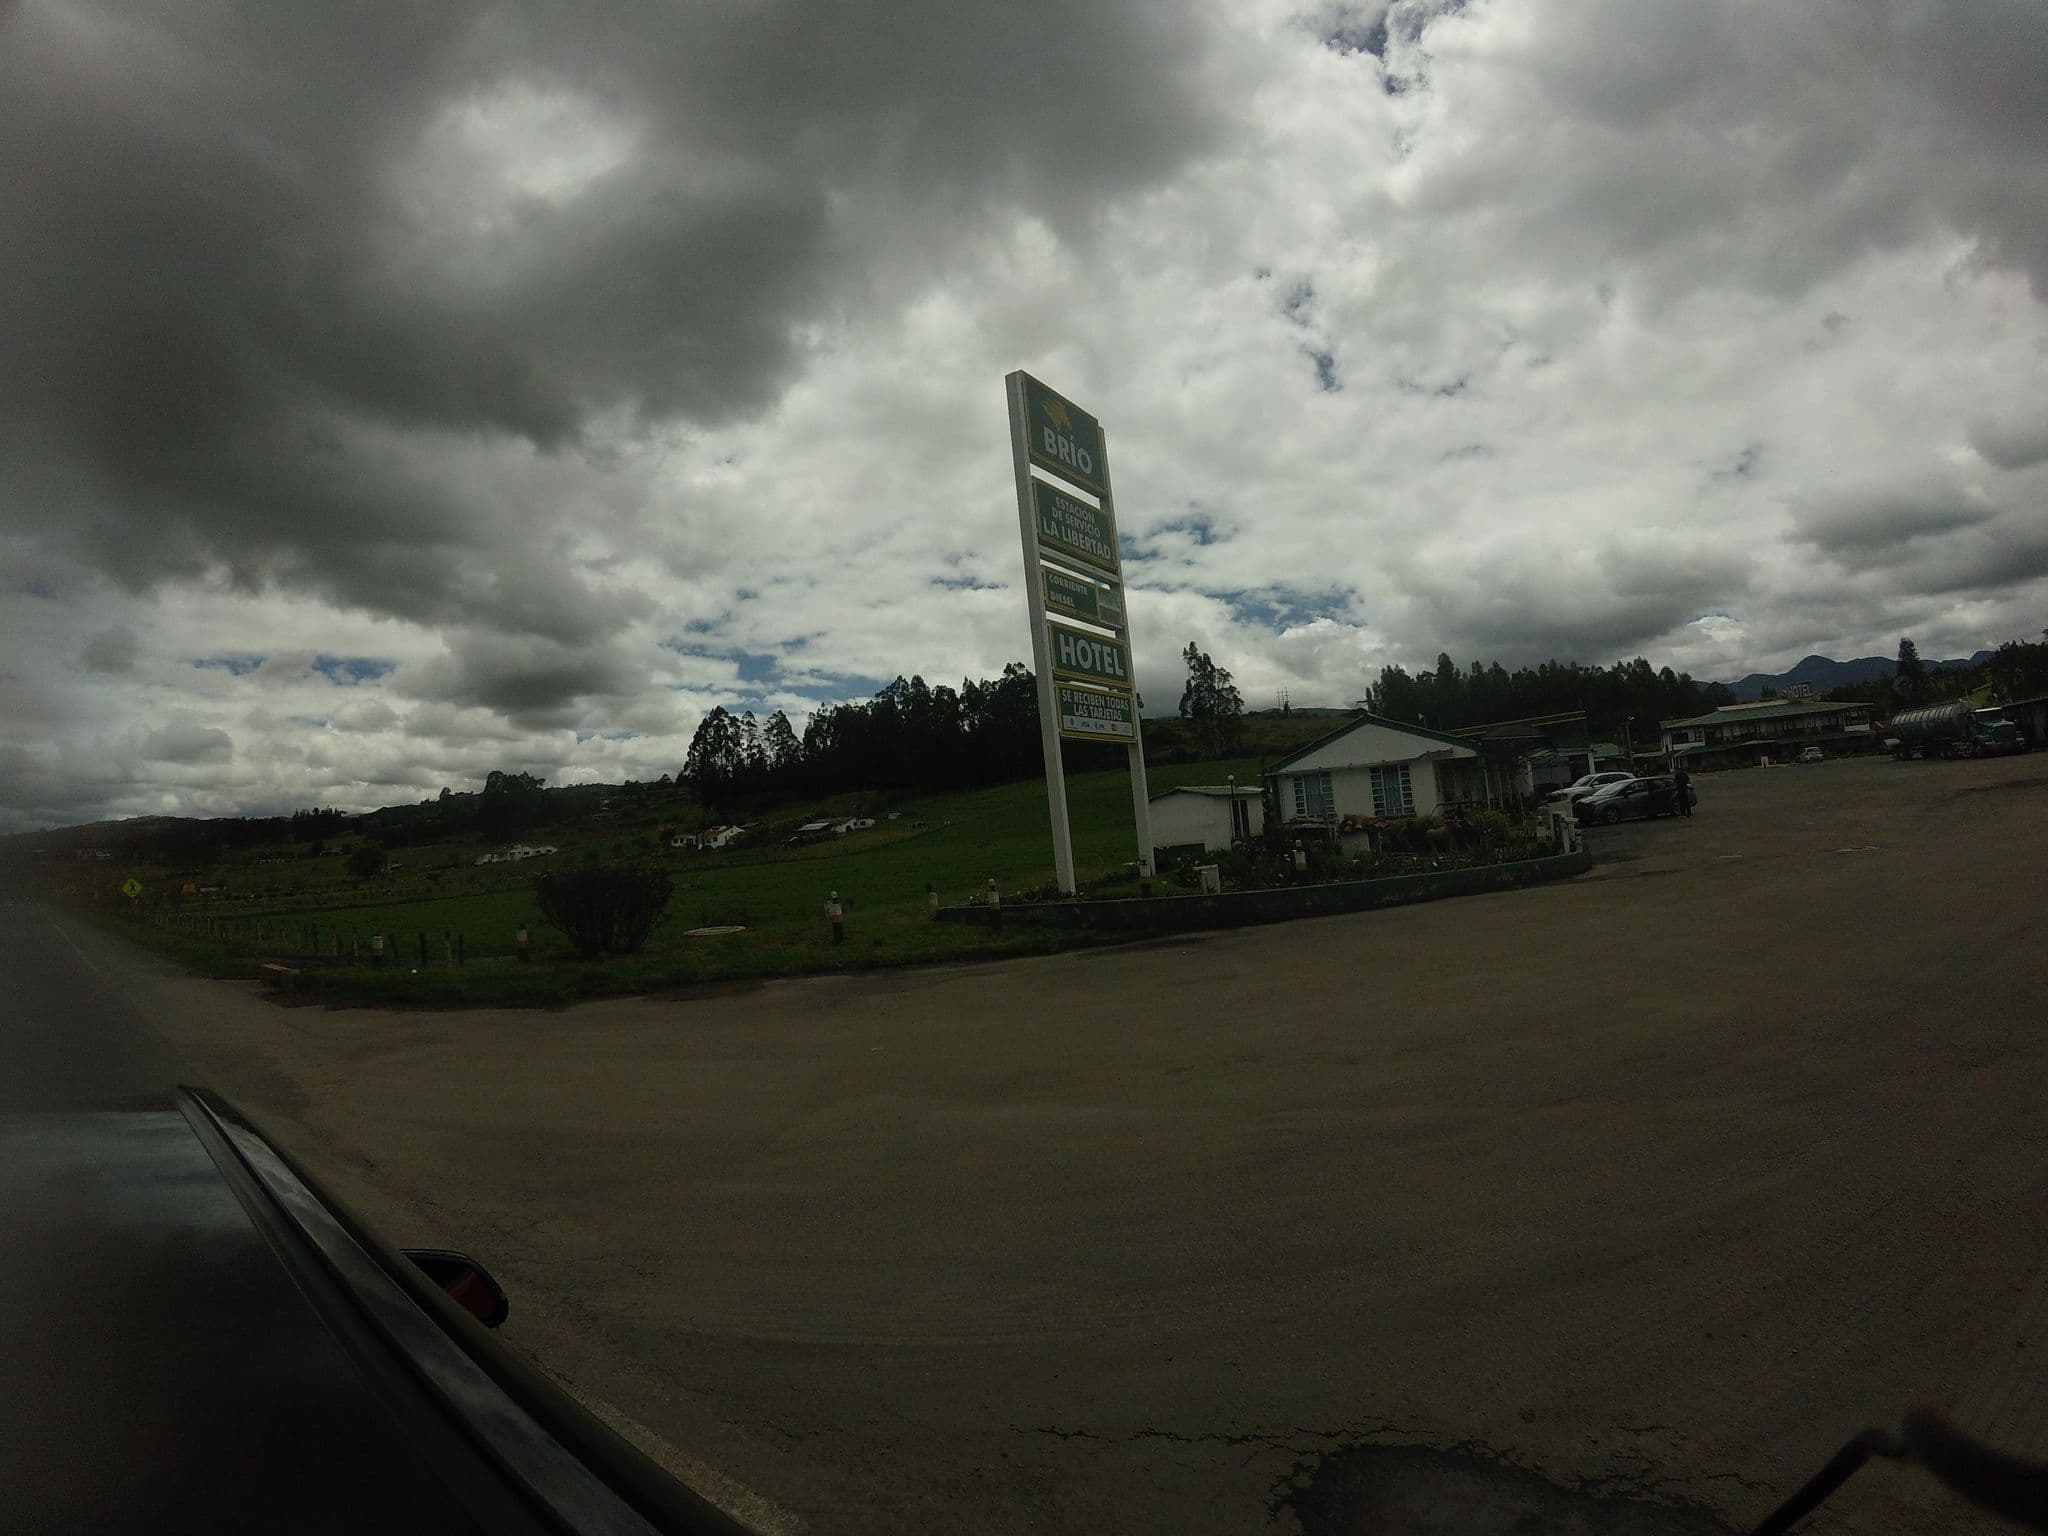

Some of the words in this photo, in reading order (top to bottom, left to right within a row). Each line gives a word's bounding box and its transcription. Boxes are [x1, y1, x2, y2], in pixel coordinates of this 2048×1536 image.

[1052, 506, 1064, 522] DE
[1065, 512, 1101, 538] SERVICIO
[1043, 517, 1060, 539] LA
[1061, 525, 1111, 560] LIBERTAD
[1050, 591, 1075, 607] DIESEL
[1058, 633, 1124, 677] HOTEL
[1062, 689, 1072, 703] SE
[1073, 690, 1105, 707] RECIBEN
[1106, 696, 1130, 711] TODAS
[1073, 703, 1089, 717] LAS
[1089, 706, 1122, 721] TARJETAS
